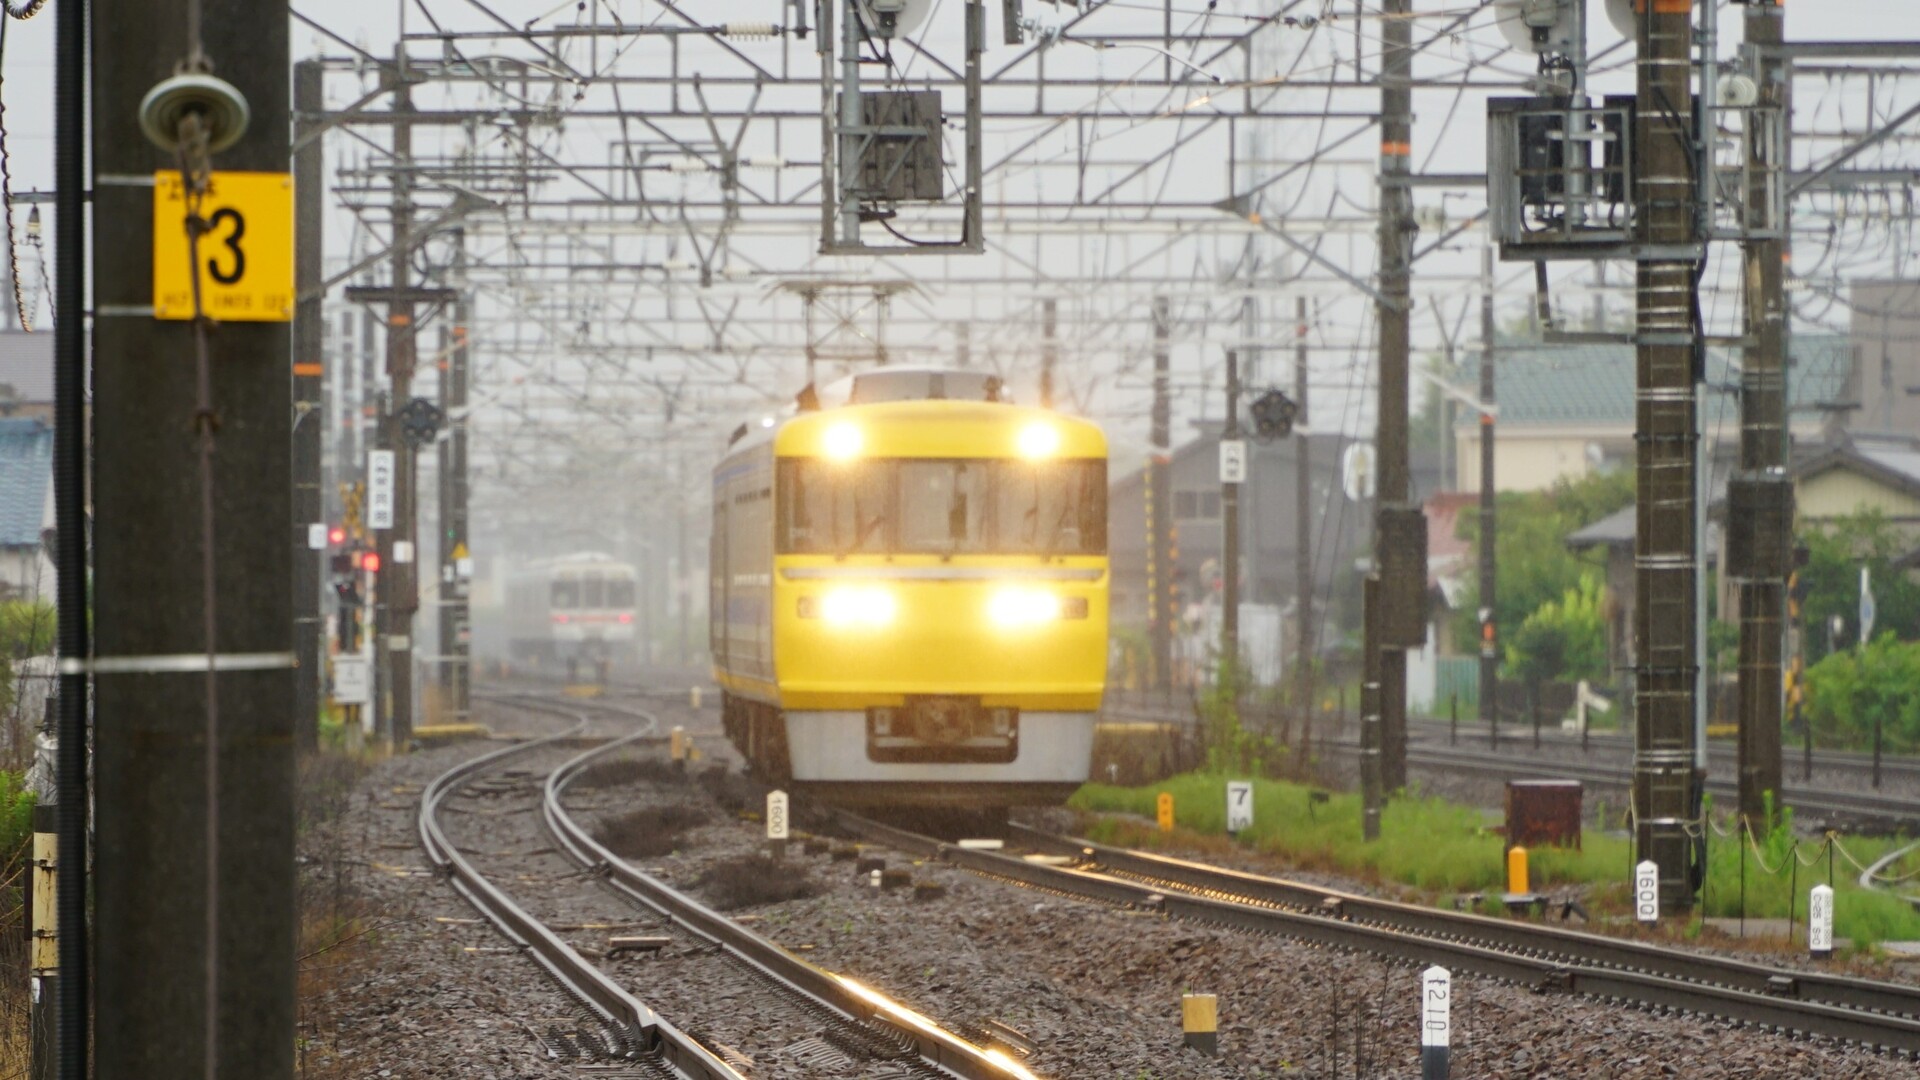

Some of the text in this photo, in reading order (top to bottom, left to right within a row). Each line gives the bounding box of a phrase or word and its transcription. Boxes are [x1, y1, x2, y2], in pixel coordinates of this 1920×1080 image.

[208, 207, 246, 286] 3
[771, 797, 783, 834] 1600
[1230, 787, 1248, 805] 7
[1639, 869, 1655, 915] 1600
